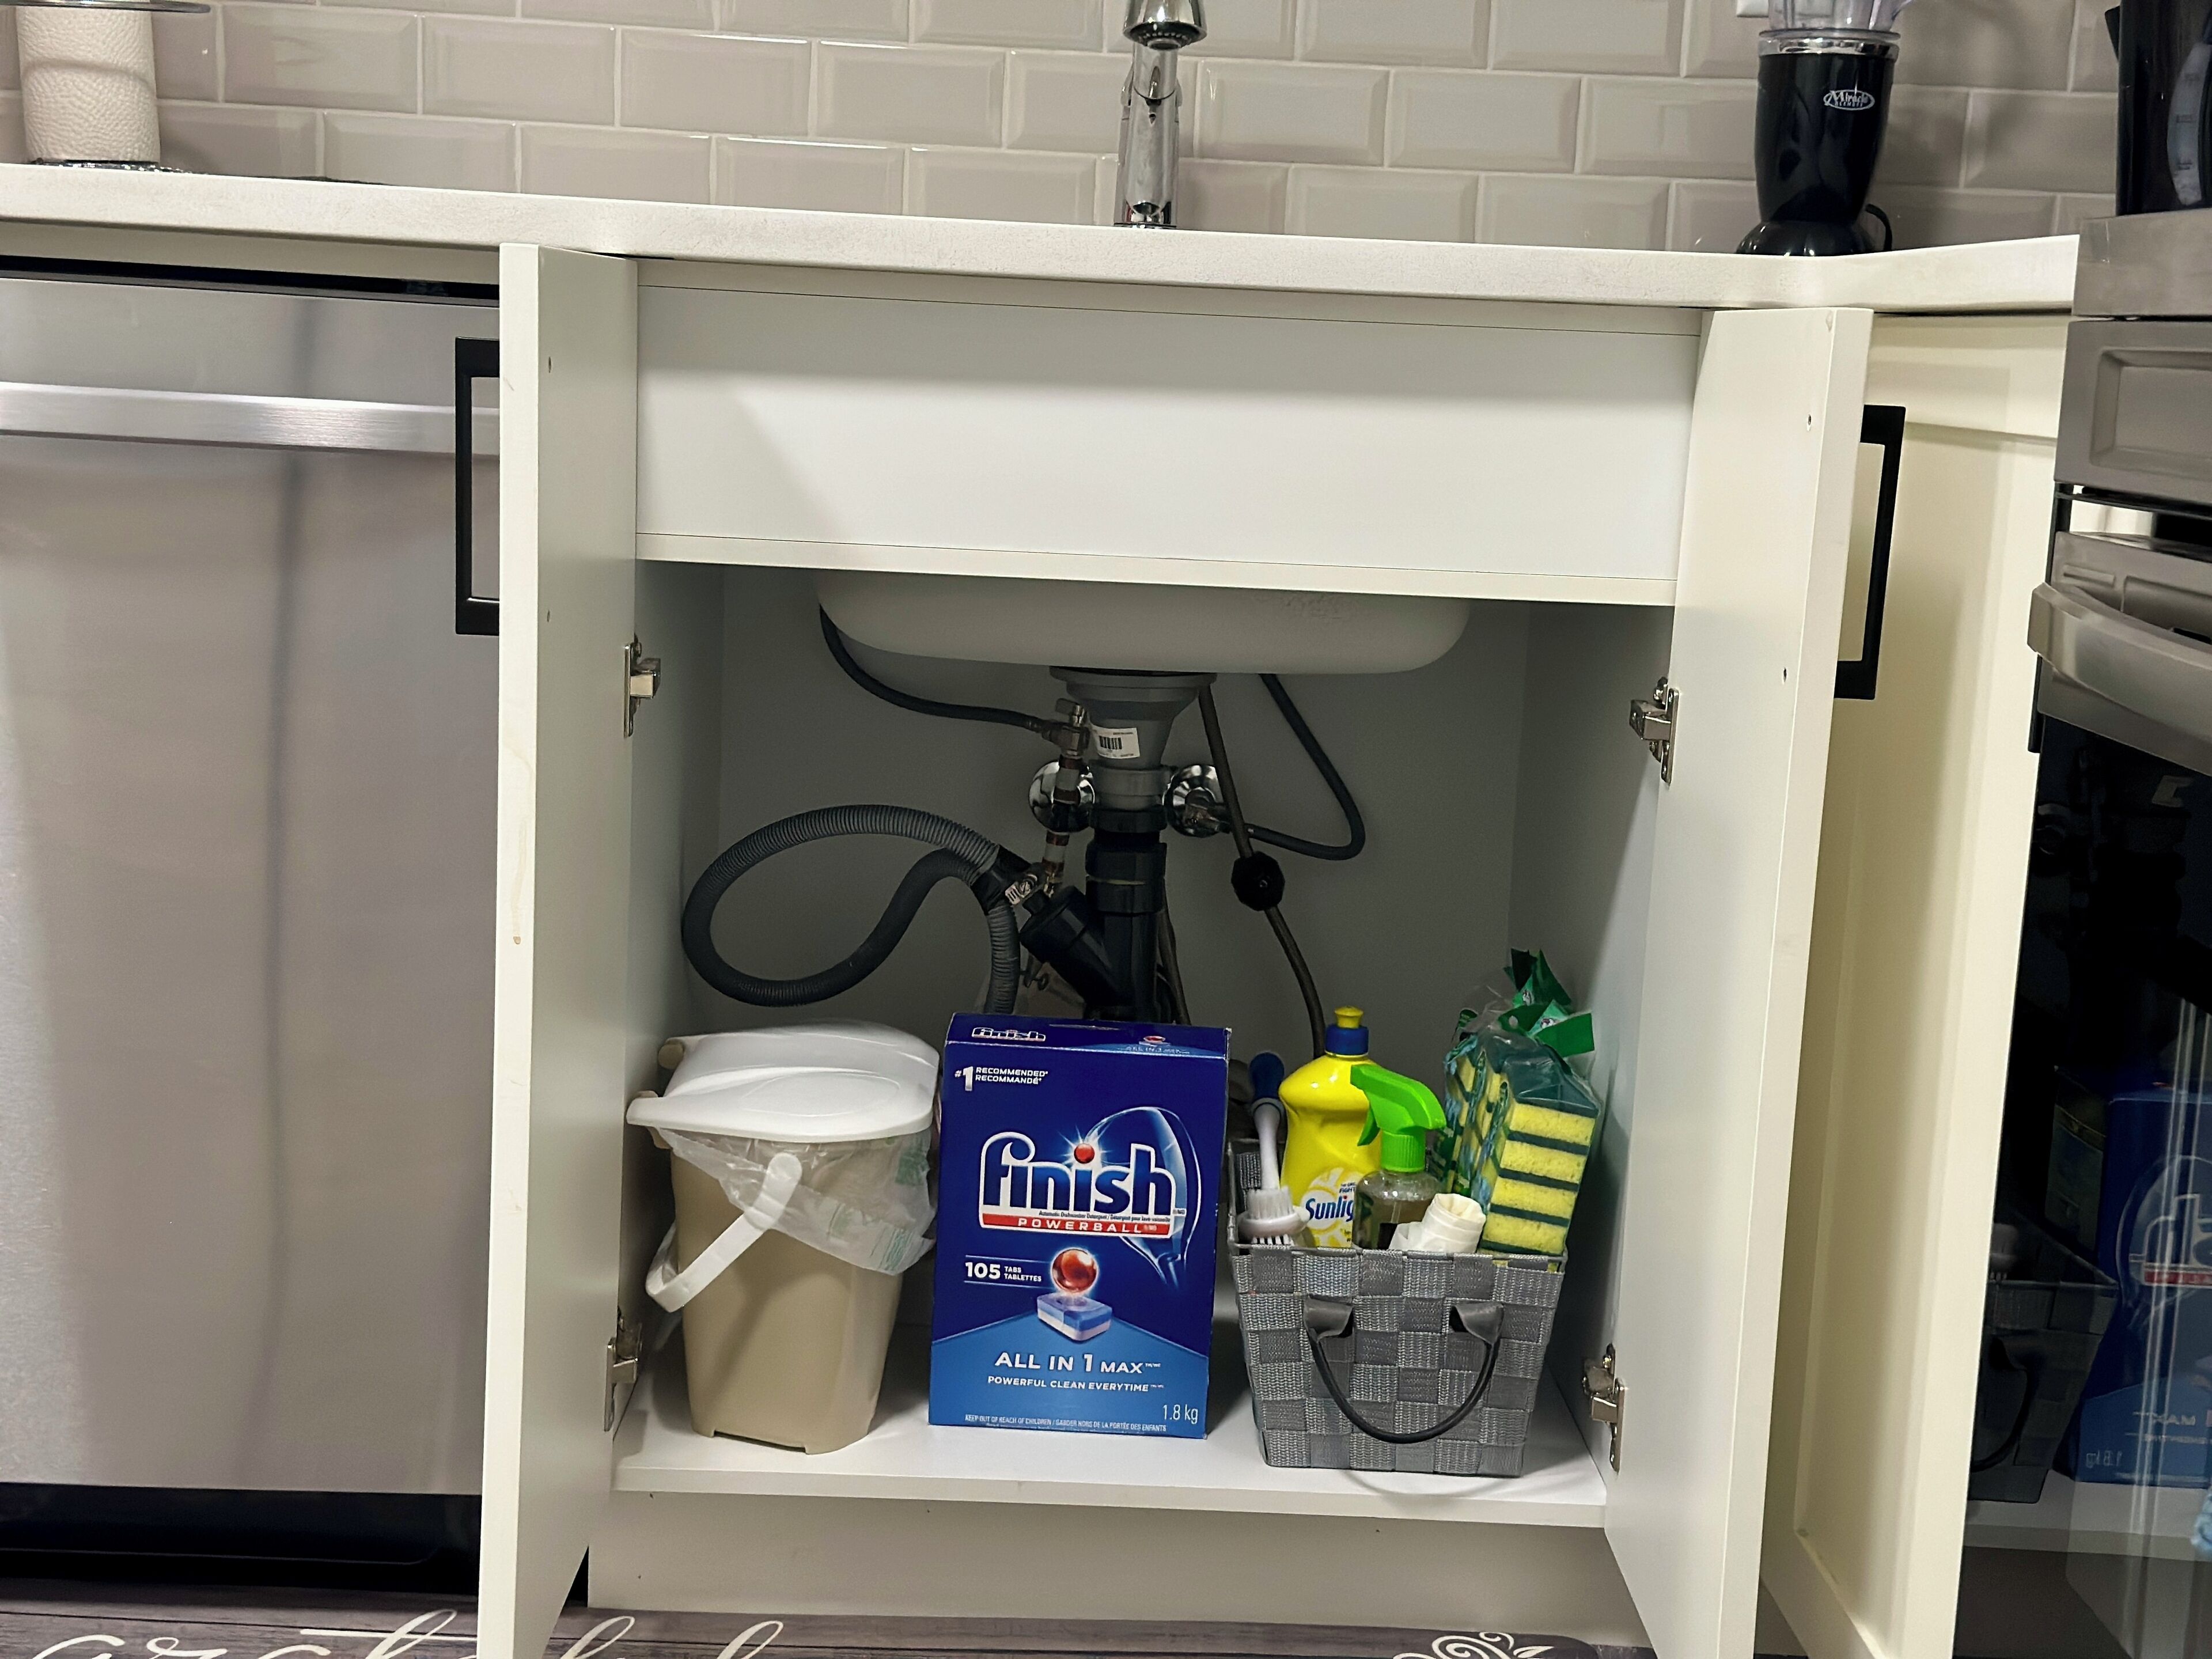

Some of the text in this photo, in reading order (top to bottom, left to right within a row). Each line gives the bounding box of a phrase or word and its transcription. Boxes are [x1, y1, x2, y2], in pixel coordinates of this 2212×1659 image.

[972, 1027, 1046, 1041] finish
[955, 1066, 974, 1091] #1
[980, 1132, 1174, 1217] finish
[1305, 1196, 1354, 1222] Sunlig
[1018, 1218, 1142, 1233] POWERBALL
[965, 1262, 1001, 1279] 105
[1003, 1273, 1042, 1282] TABLETTES
[994, 1352, 1041, 1369] ALL
[1049, 1355, 1074, 1371] IN
[1084, 1354, 1093, 1372] 1
[1100, 1361, 1143, 1374] MAX
[988, 1376, 1047, 1388] POWERFUL
[1050, 1380, 1086, 1389] CLEAN
[1088, 1382, 1149, 1392] EVERYTIME
[965, 1414, 978, 1422] KEEP
[1025, 1418, 1051, 1426] CHILDREN
[1142, 1424, 1166, 1432] ENFANTS
[1162, 1404, 1198, 1425] 1.8 kg
